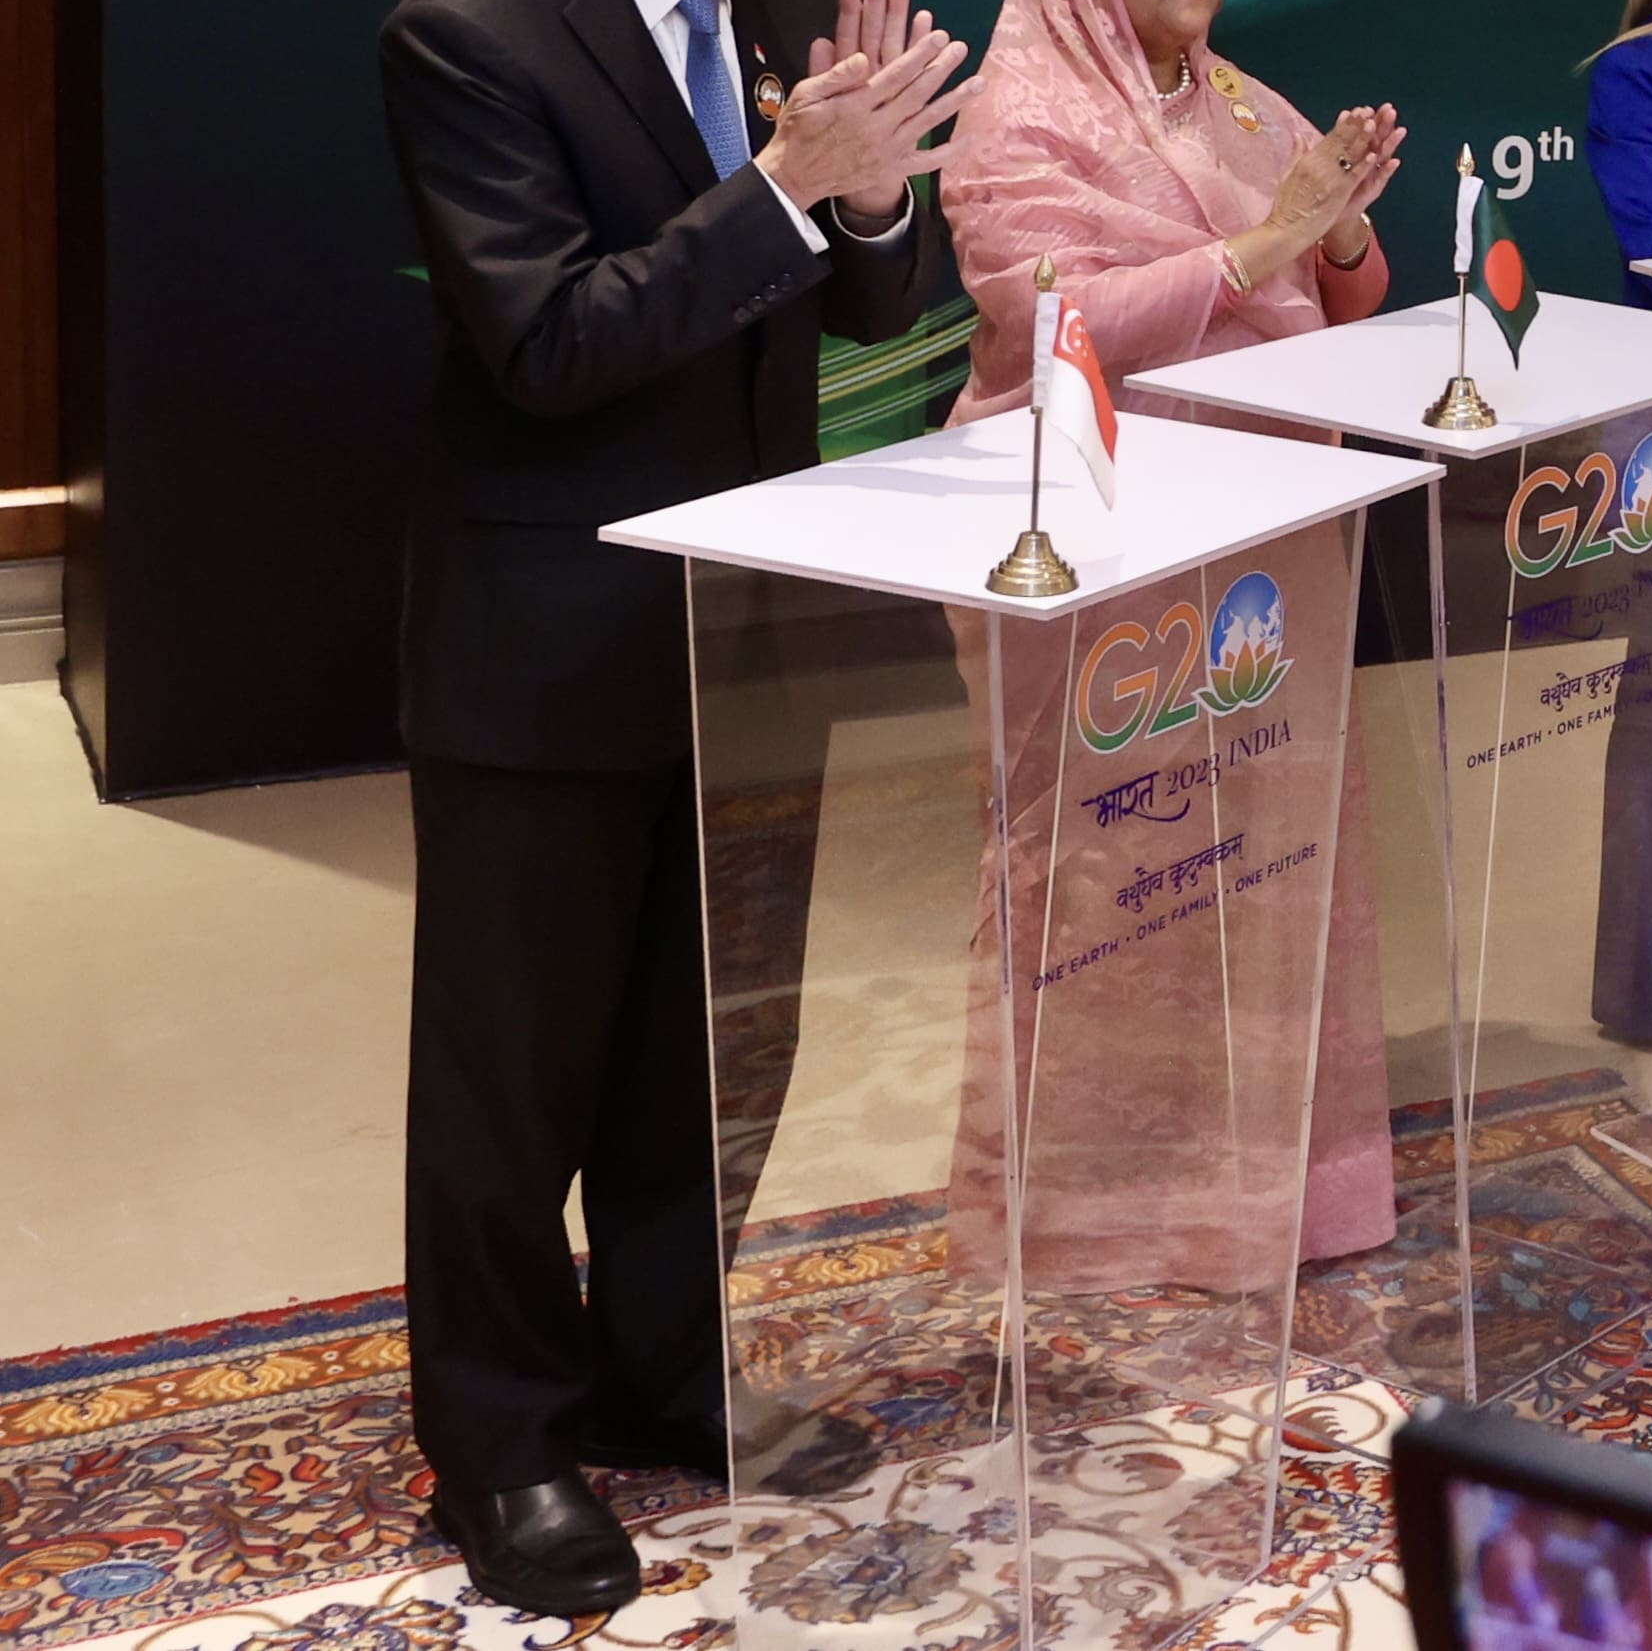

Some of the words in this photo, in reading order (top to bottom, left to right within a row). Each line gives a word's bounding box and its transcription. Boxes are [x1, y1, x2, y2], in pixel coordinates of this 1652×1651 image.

[1492, 126, 1575, 200] 9th
[1075, 570, 1296, 755] G20
[1081, 770, 1190, 828] भारत
[1166, 752, 1221, 798] 2023
[1229, 718, 1293, 767] INDIA
[1466, 747, 1496, 769] ONE
[1498, 730, 1543, 759] EARTH
[1556, 715, 1584, 737] ONE
[1031, 964, 1065, 992] ONE
[1069, 938, 1119, 974] EARTH
[1136, 918, 1166, 940] ONE
[1171, 890, 1220, 923] FAMILY
[1235, 870, 1264, 893] ONE
[1267, 842, 1319, 878] FUTURE
